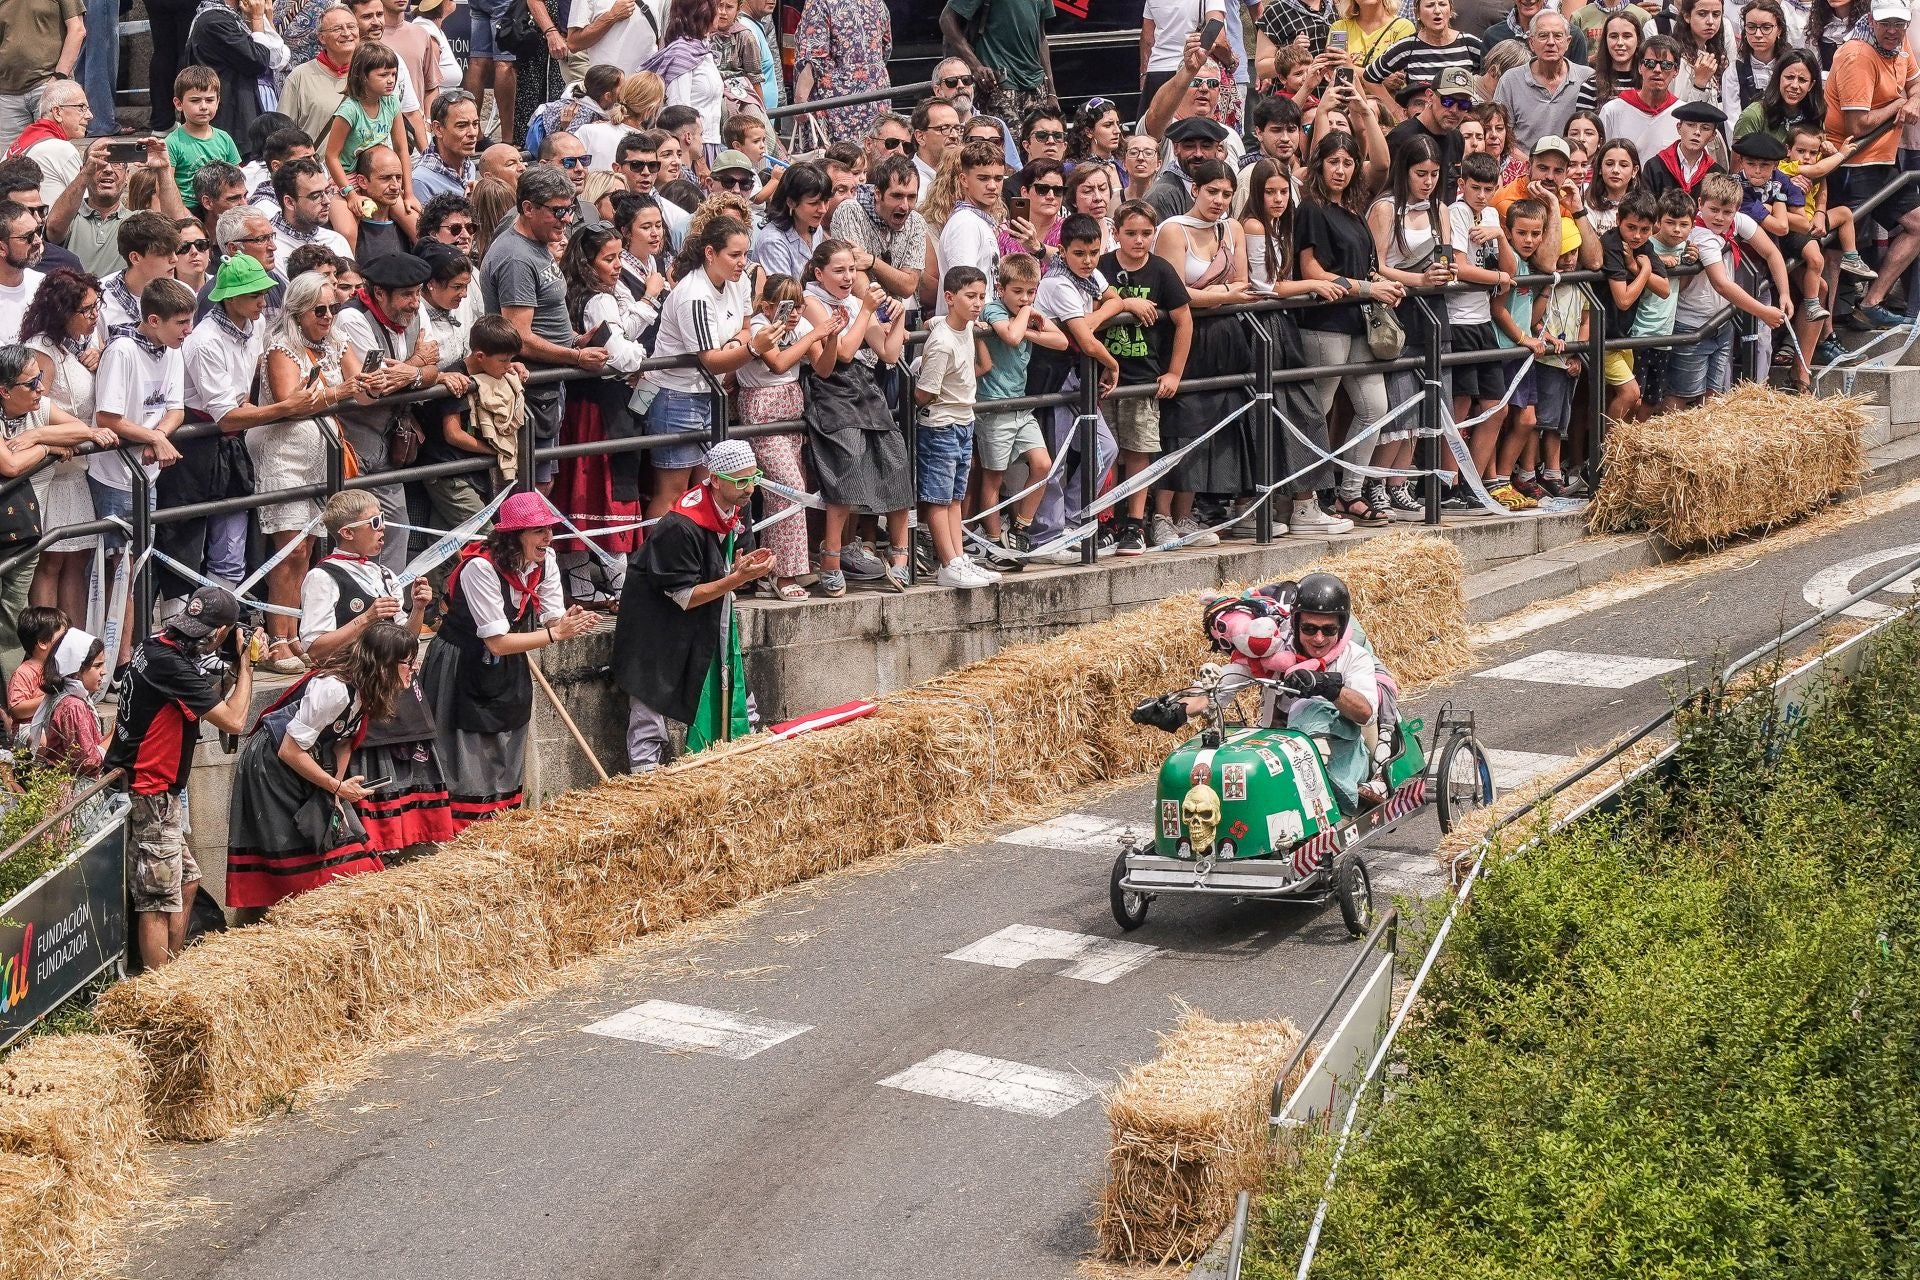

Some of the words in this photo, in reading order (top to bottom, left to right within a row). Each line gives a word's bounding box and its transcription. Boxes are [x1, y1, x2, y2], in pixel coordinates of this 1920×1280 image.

[440, 536, 463, 558] Vital
[37, 900, 89, 957] FUNDACIÓN
[37, 930, 88, 985] FUNDAZIOA
